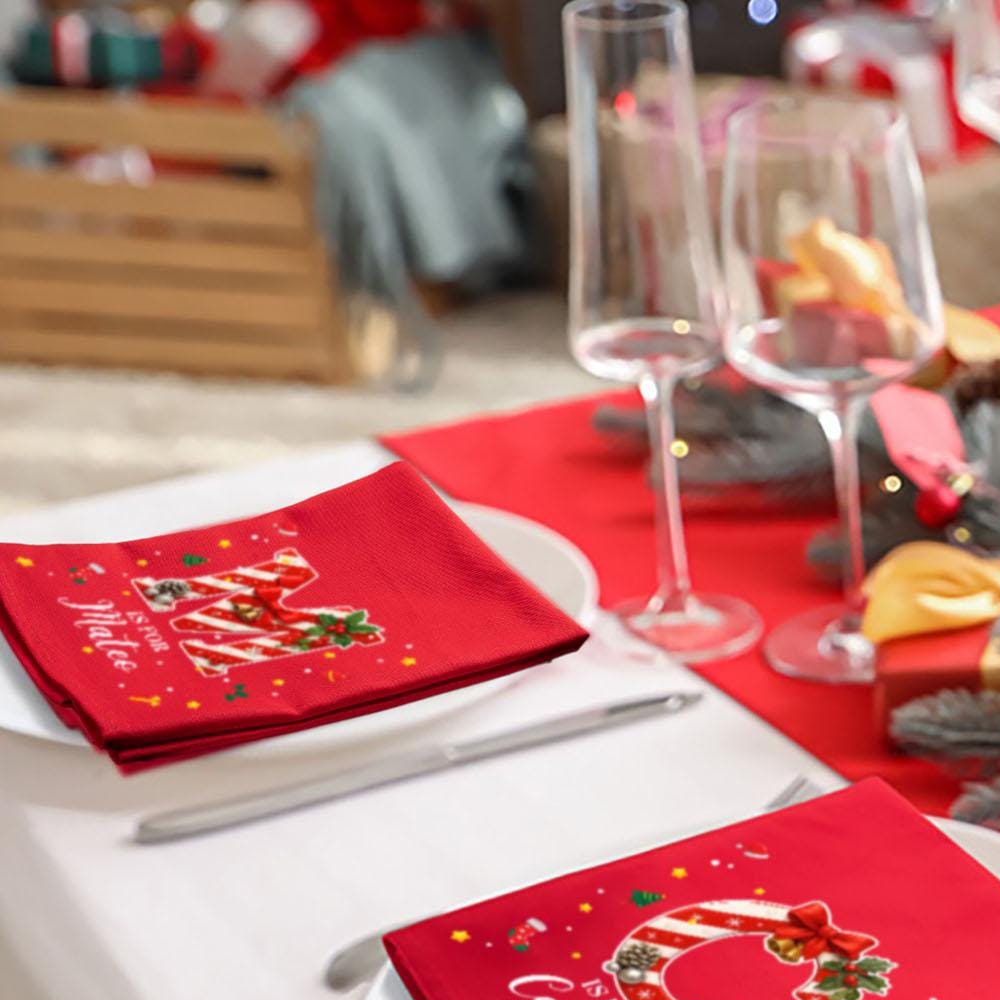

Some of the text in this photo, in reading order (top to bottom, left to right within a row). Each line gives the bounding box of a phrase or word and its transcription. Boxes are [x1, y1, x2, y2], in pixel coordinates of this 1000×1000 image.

[57, 597, 139, 673] Mateo
[125, 611, 170, 652] IS FOR
[131, 547, 385, 678] M
[581, 978, 610, 998] IS
